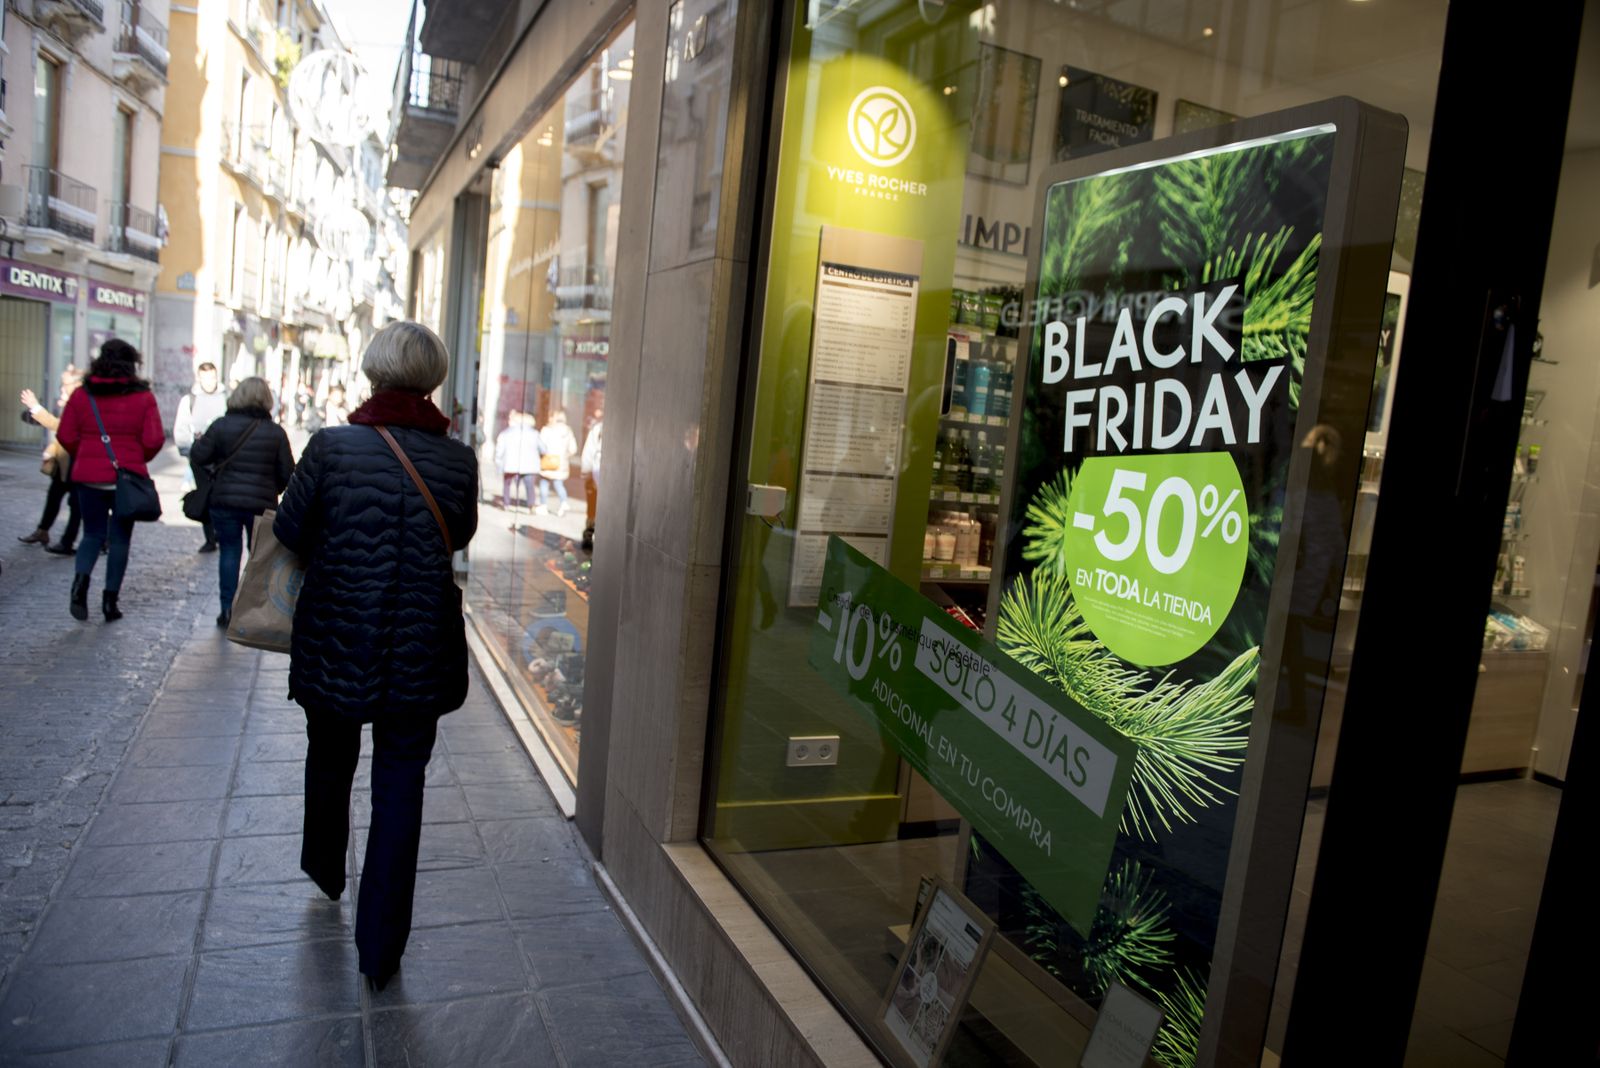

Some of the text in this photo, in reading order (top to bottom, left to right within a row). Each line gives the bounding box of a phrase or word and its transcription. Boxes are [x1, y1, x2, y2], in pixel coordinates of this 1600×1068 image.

[1075, 108, 1139, 138] TRATAMIENTO
[1088, 128, 1121, 148] FACIAL
[827, 165, 928, 196] YVES ROCHER
[854, 187, 898, 201] FRANCE
[10, 266, 63, 294] DENTIX
[96, 286, 135, 309] DENTIX
[1042, 284, 1239, 384] BLACK
[1063, 365, 1285, 453] FRIDAY
[1073, 468, 1242, 575] -50%
[859, 604, 871, 620] de
[1076, 568, 1094, 589] EN
[1095, 568, 1140, 603] TODA
[1143, 587, 1161, 611] LA
[1163, 592, 1212, 626] TIENDA
[817, 591, 902, 680] -10%
[929, 640, 1090, 788] SOLO 4 DÍAS
[872, 677, 1053, 857] ADICIONAL EN TU COMPRA
